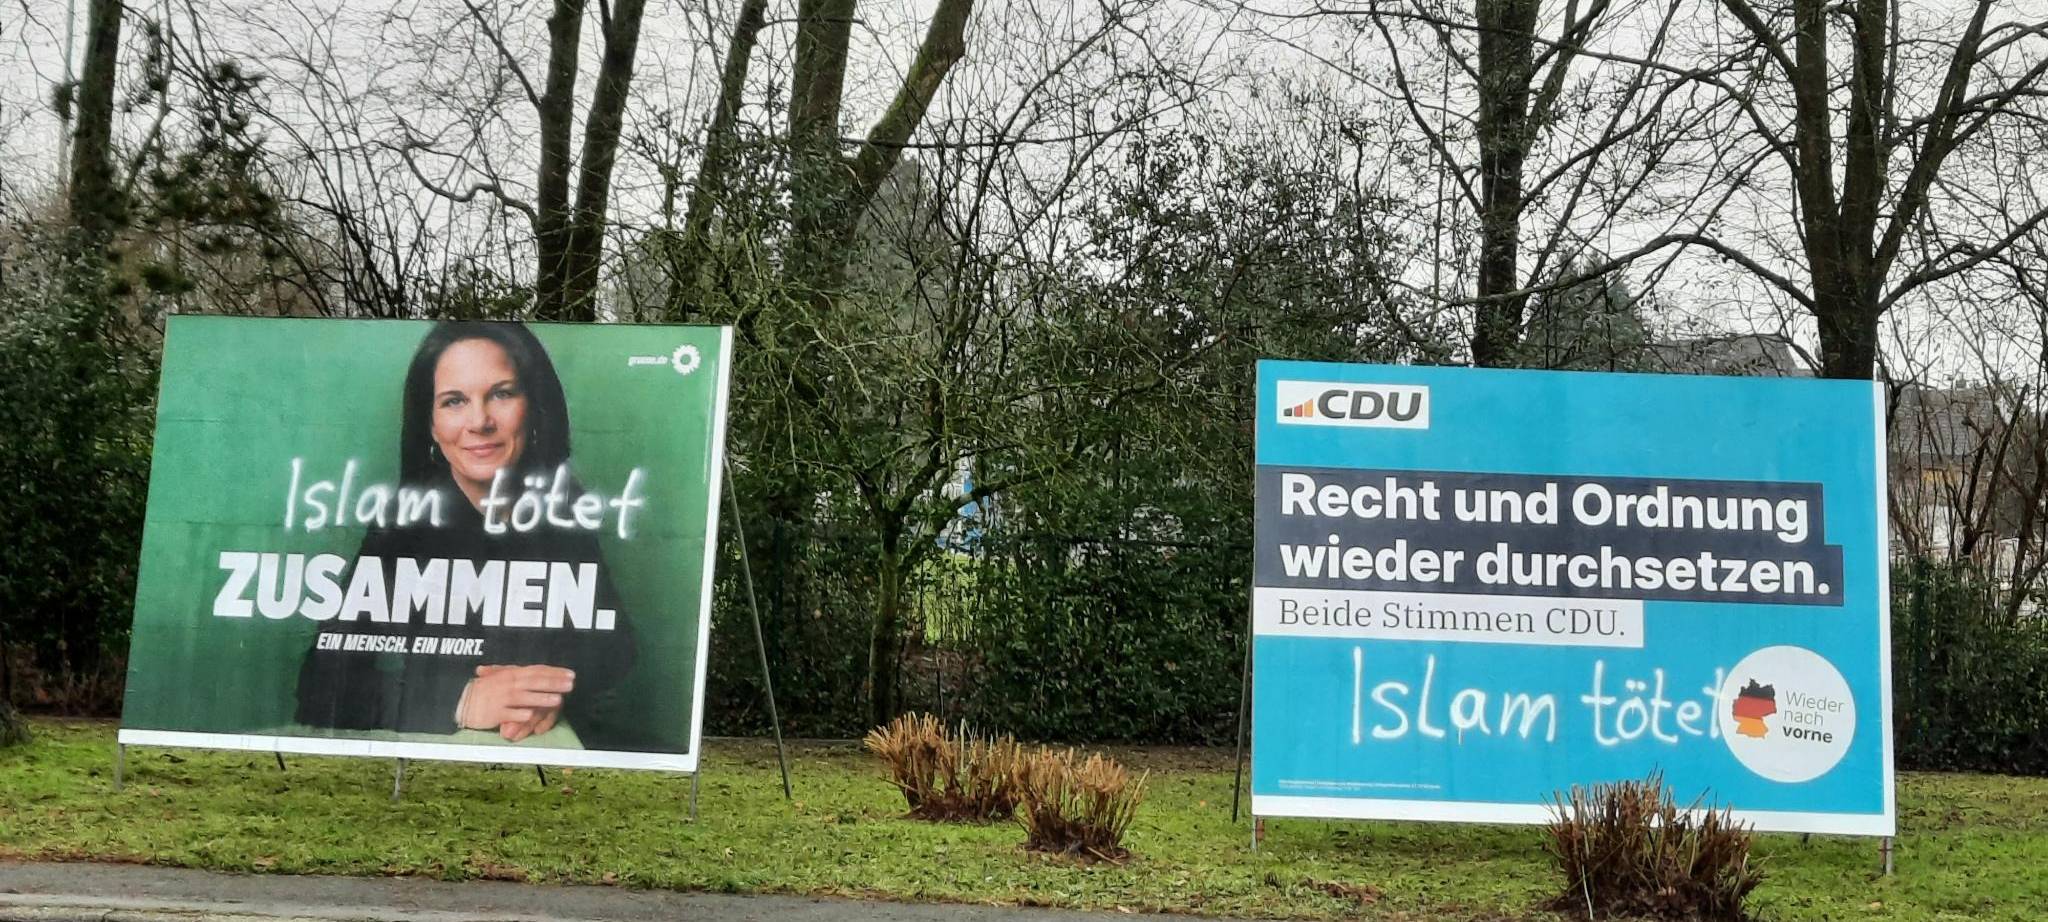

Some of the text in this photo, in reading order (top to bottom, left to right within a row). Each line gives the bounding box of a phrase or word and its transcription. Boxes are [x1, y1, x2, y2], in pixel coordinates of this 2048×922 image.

[1317, 389, 1422, 422] CDU
[285, 457, 646, 539] Islam tötet
[1280, 472, 1809, 544] Recht und Ordnung
[1280, 534, 1831, 595] wieder durchsetzen.
[213, 551, 617, 631] ZUSAMMEN.
[1279, 599, 1626, 636] Beide Stimmen CDU.
[316, 633, 485, 656] EIN MENSCH. EIN WORT.
[1783, 709, 1824, 726] nach
[1785, 689, 1845, 713] Wieder
[1782, 726, 1833, 744] vorne
